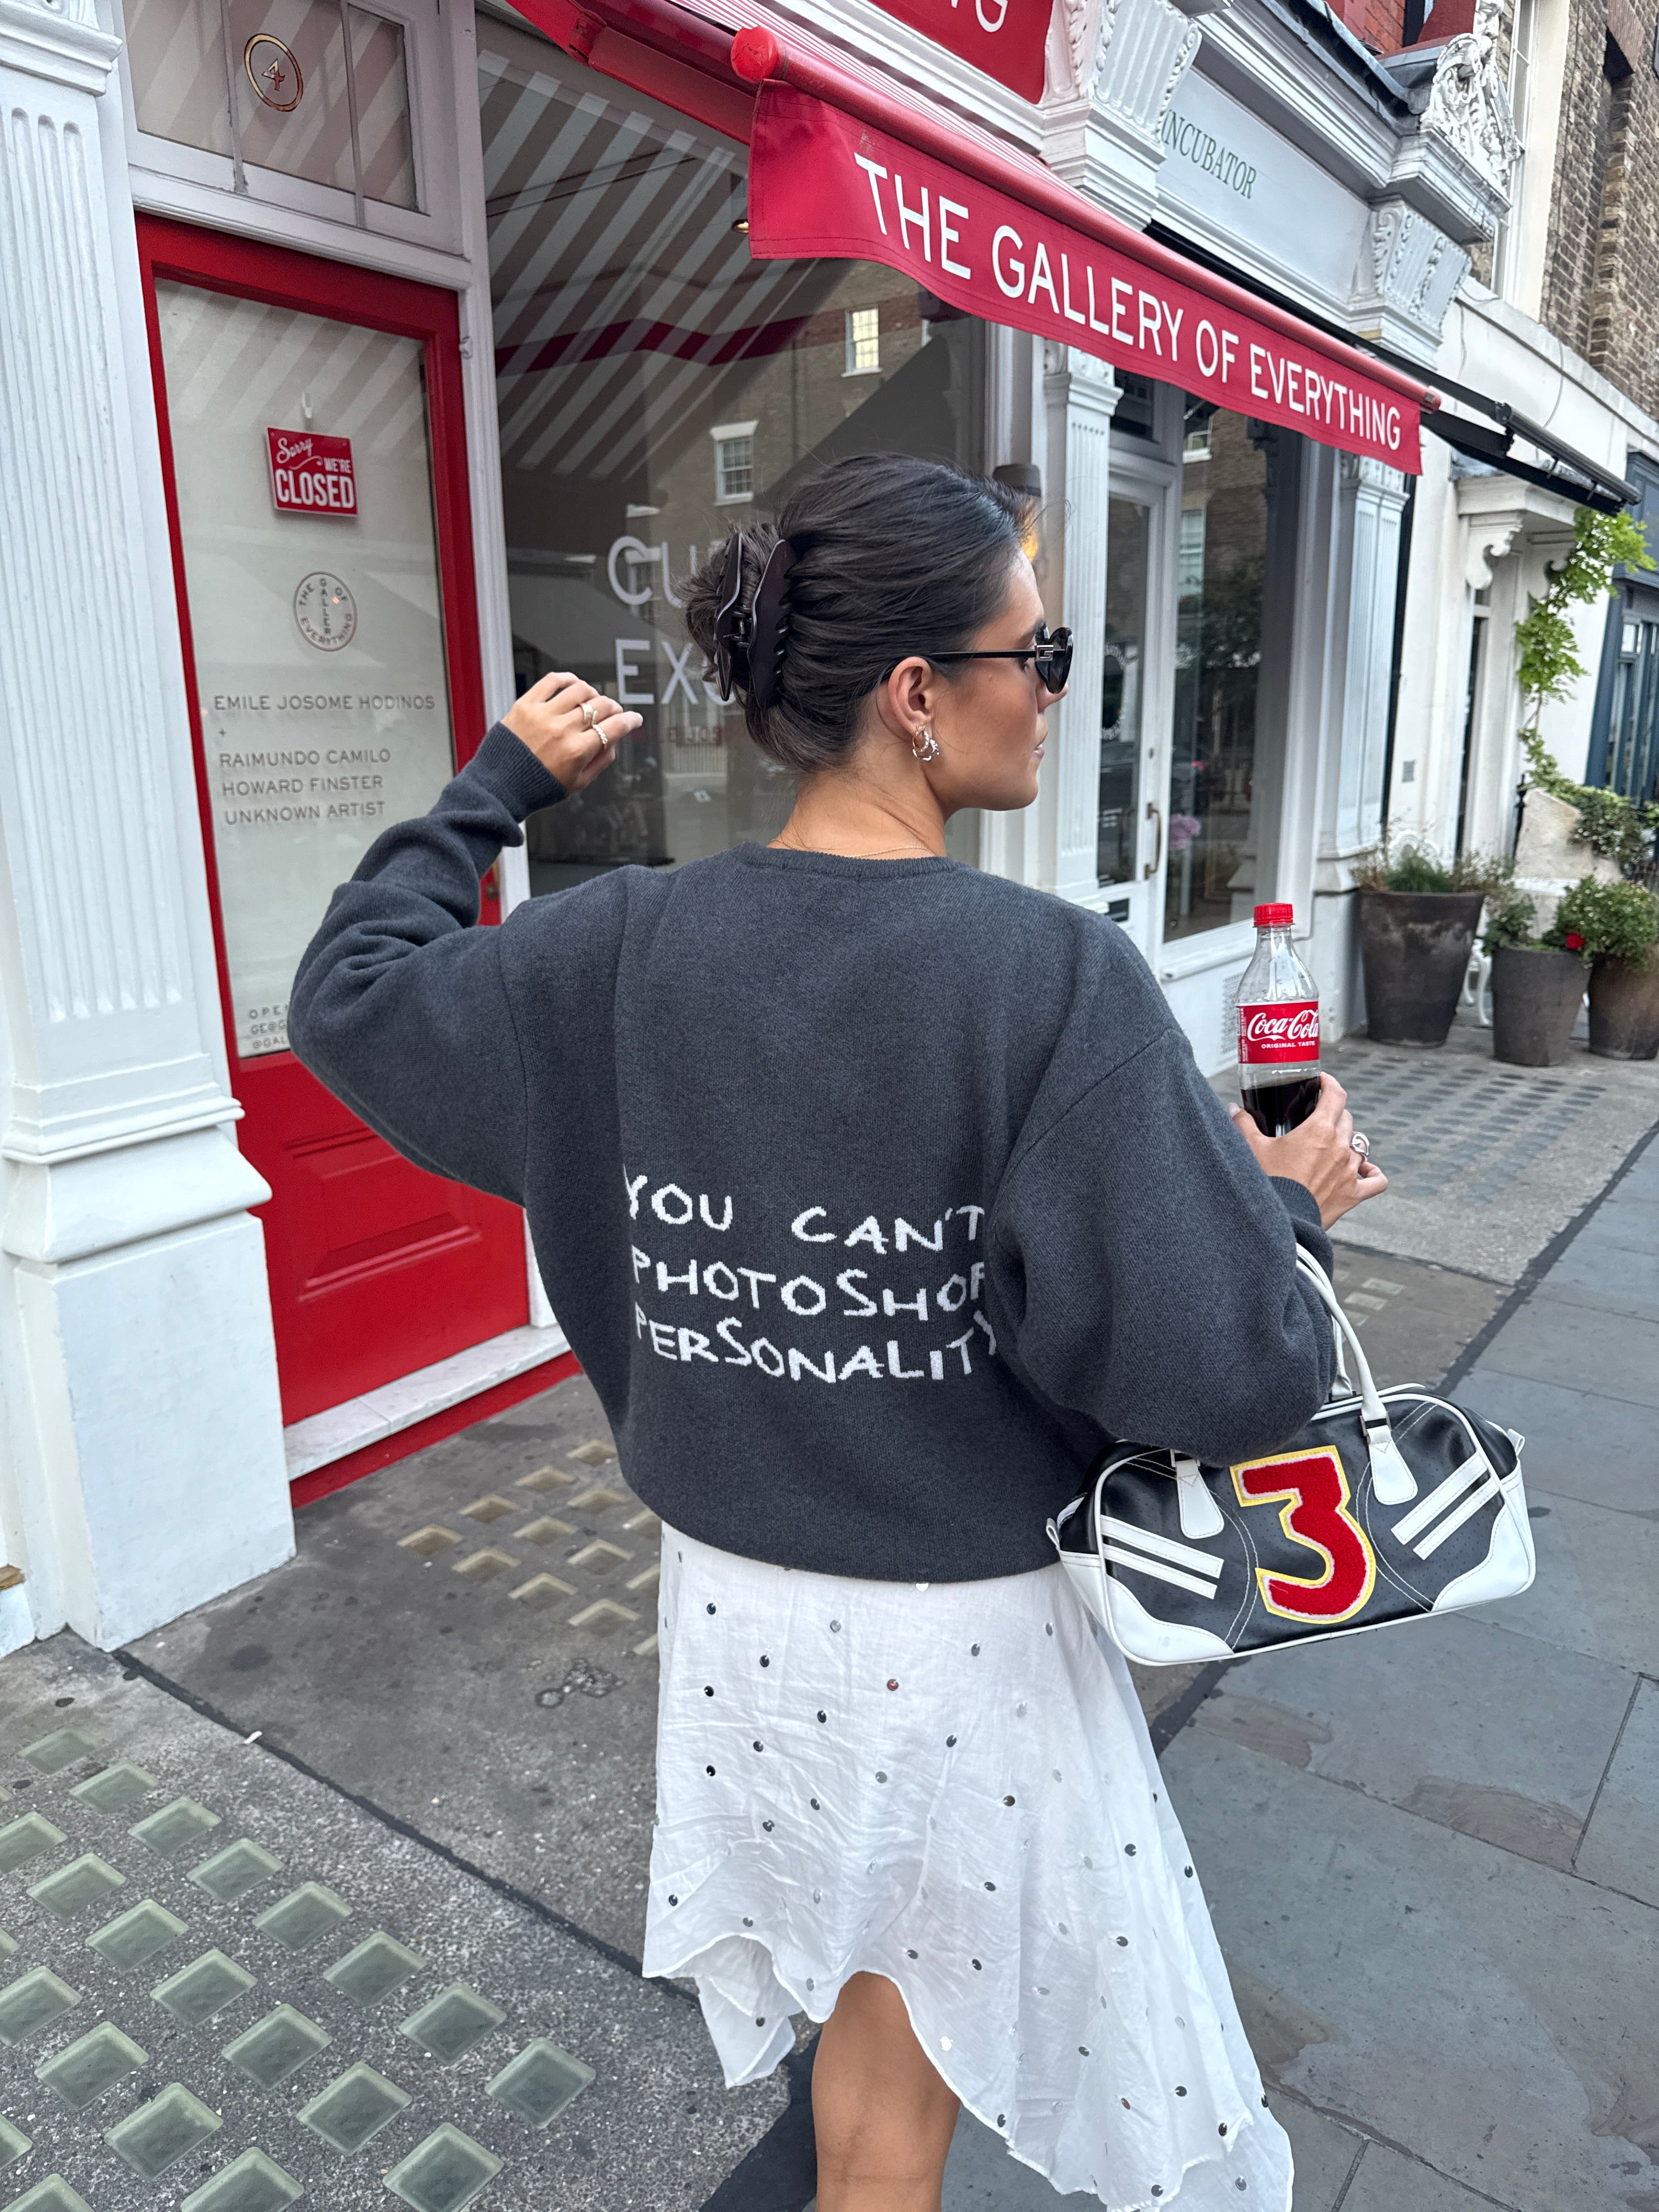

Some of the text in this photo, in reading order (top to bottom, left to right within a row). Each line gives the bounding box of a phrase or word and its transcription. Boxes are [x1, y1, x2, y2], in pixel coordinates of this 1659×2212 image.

[262, 58, 285, 92] 4
[1161, 110, 1257, 199] INCUBATOR
[854, 152, 1401, 451] THE GALLERY OF EVERYTHING
[276, 437, 313, 464] Sorry
[324, 456, 352, 473] WE'RE
[275, 469, 355, 508] CLOSED
[607, 535, 698, 608] CU
[615, 639, 736, 706] EX
[214, 695, 436, 710] EMILE JOSOME HODINOS
[219, 748, 391, 768] RAIMUNDO CAMILO
[222, 775, 383, 796] HOWARD FINSTER
[225, 801, 386, 825] UNKNOWN ARTIST
[249, 1003, 289, 1020] OPE
[1247, 1009, 1319, 1042] Coca-Cola
[251, 1019, 286, 1035] GE@G
[252, 1036, 287, 1050] @GAL
[623, 1164, 985, 1255] YOU CAN'T
[1229, 1446, 1376, 1624] 3
